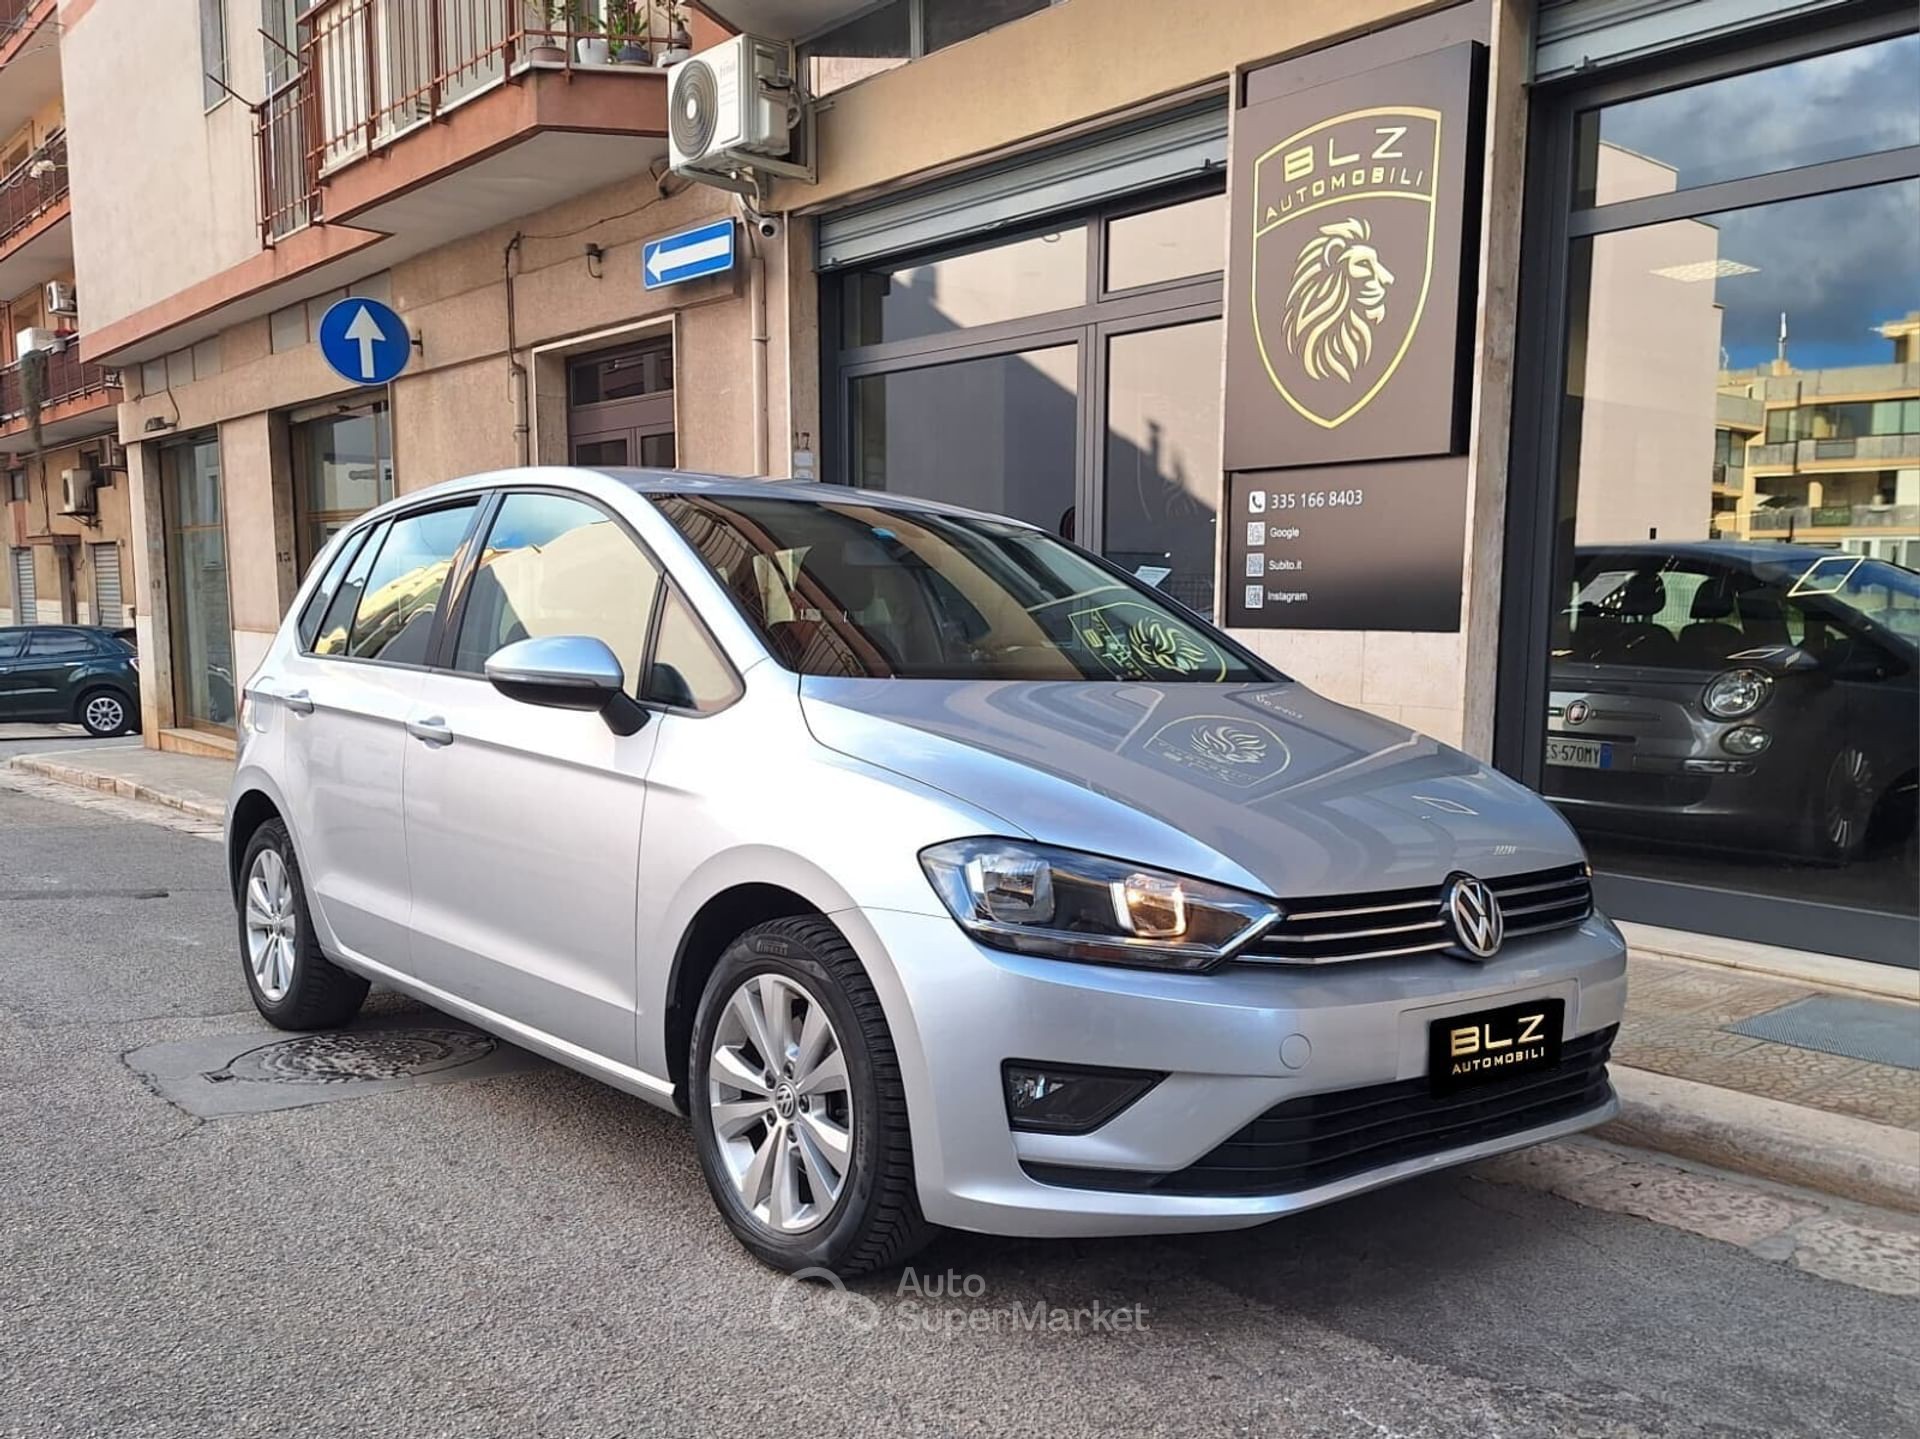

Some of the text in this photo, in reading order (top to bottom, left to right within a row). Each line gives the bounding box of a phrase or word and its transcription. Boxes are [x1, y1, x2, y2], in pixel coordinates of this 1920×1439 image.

[1284, 126, 1408, 182] BLZ
[1265, 166, 1423, 222] AUTOMOBILI
[1271, 489, 1363, 509] 335 166 8403
[1269, 526, 1300, 540] Google
[1268, 559, 1302, 571] Subito.it
[1266, 590, 1308, 603] Instagram
[1450, 1014, 1545, 1057] BLZ
[1451, 1046, 1545, 1075] AUTOMOBILI
